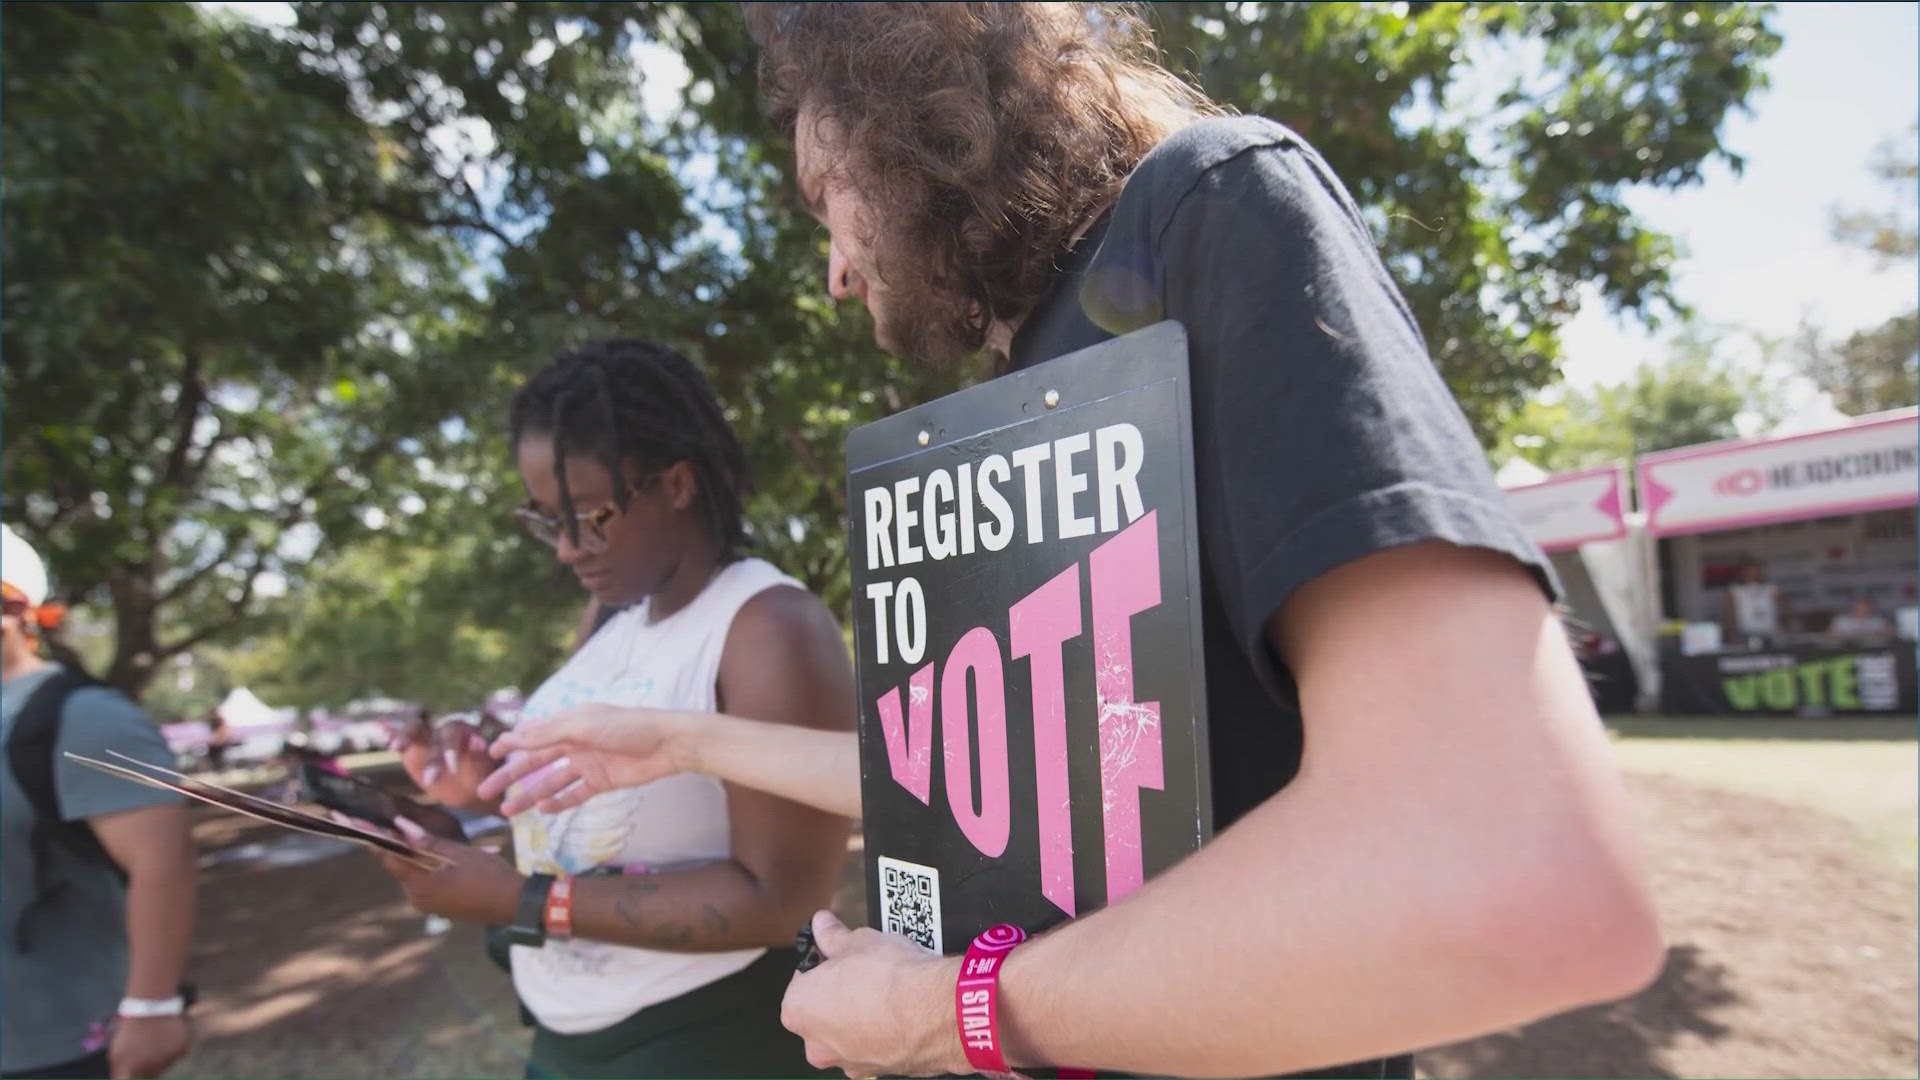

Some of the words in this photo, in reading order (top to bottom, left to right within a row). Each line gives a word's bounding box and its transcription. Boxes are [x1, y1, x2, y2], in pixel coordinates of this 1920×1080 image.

[864, 423, 1145, 570] REGISTER
[1767, 446, 1918, 490] HEADCOUN
[866, 577, 927, 665] TO
[876, 509, 1165, 919] VOTE
[1724, 656, 1863, 711] VOTE
[962, 989, 994, 1051] STAFF
